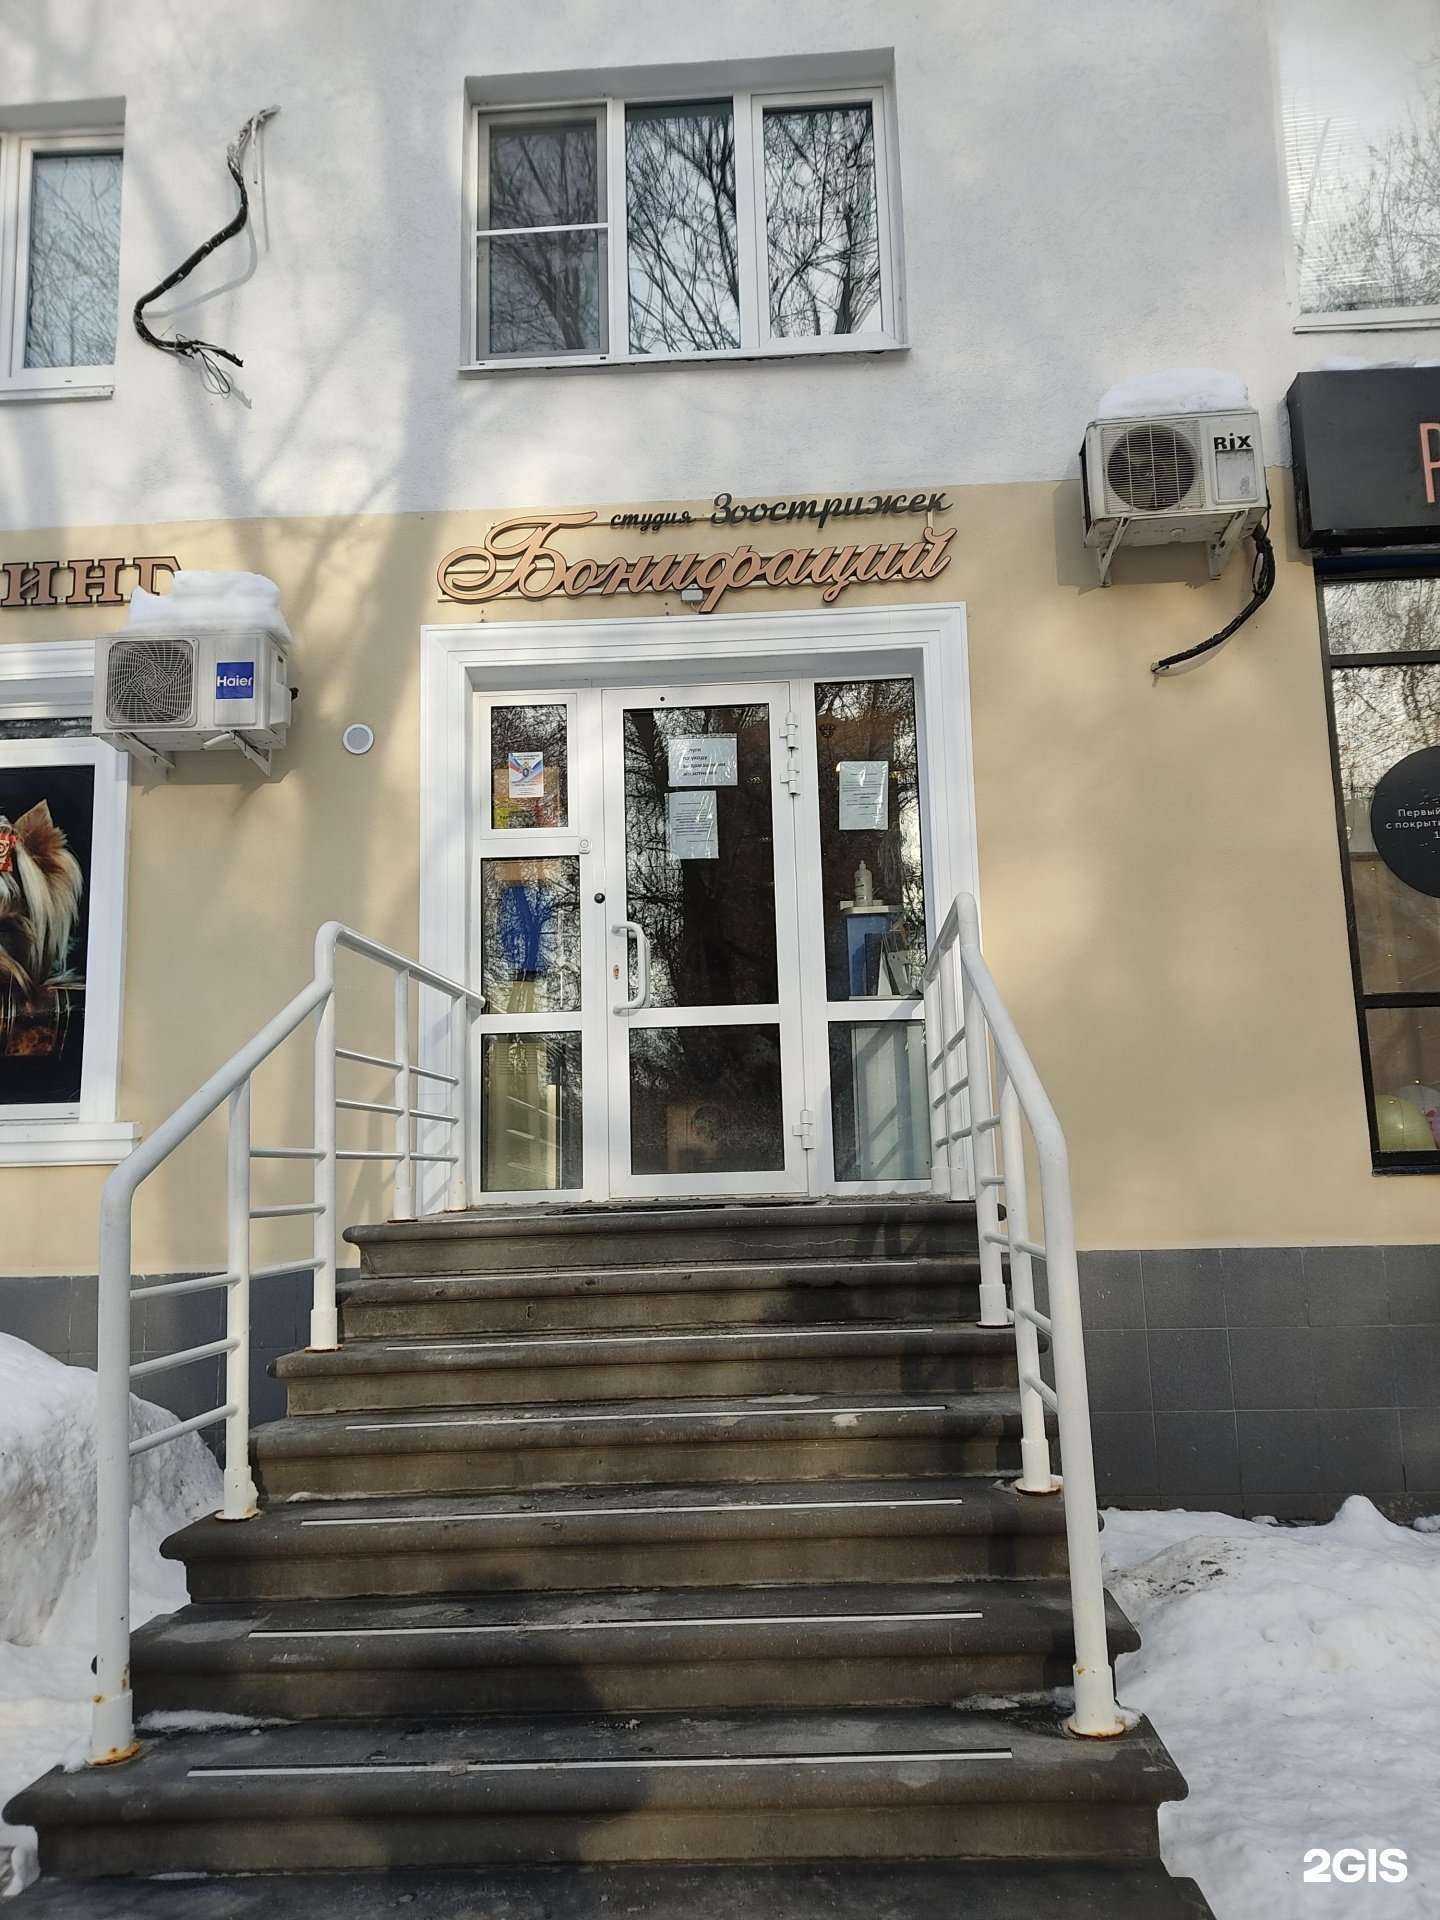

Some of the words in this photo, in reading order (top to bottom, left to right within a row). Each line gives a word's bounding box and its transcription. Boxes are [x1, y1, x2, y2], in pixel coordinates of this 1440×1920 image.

[610, 509, 695, 531] студия
[709, 492, 953, 529] Зоострижек
[437, 510, 958, 613] Бонифаций
[0, 556, 183, 608] ИНГ
[216, 674, 253, 688] Haier
[1398, 807, 1440, 818] Первый
[1385, 822, 1393, 830] с
